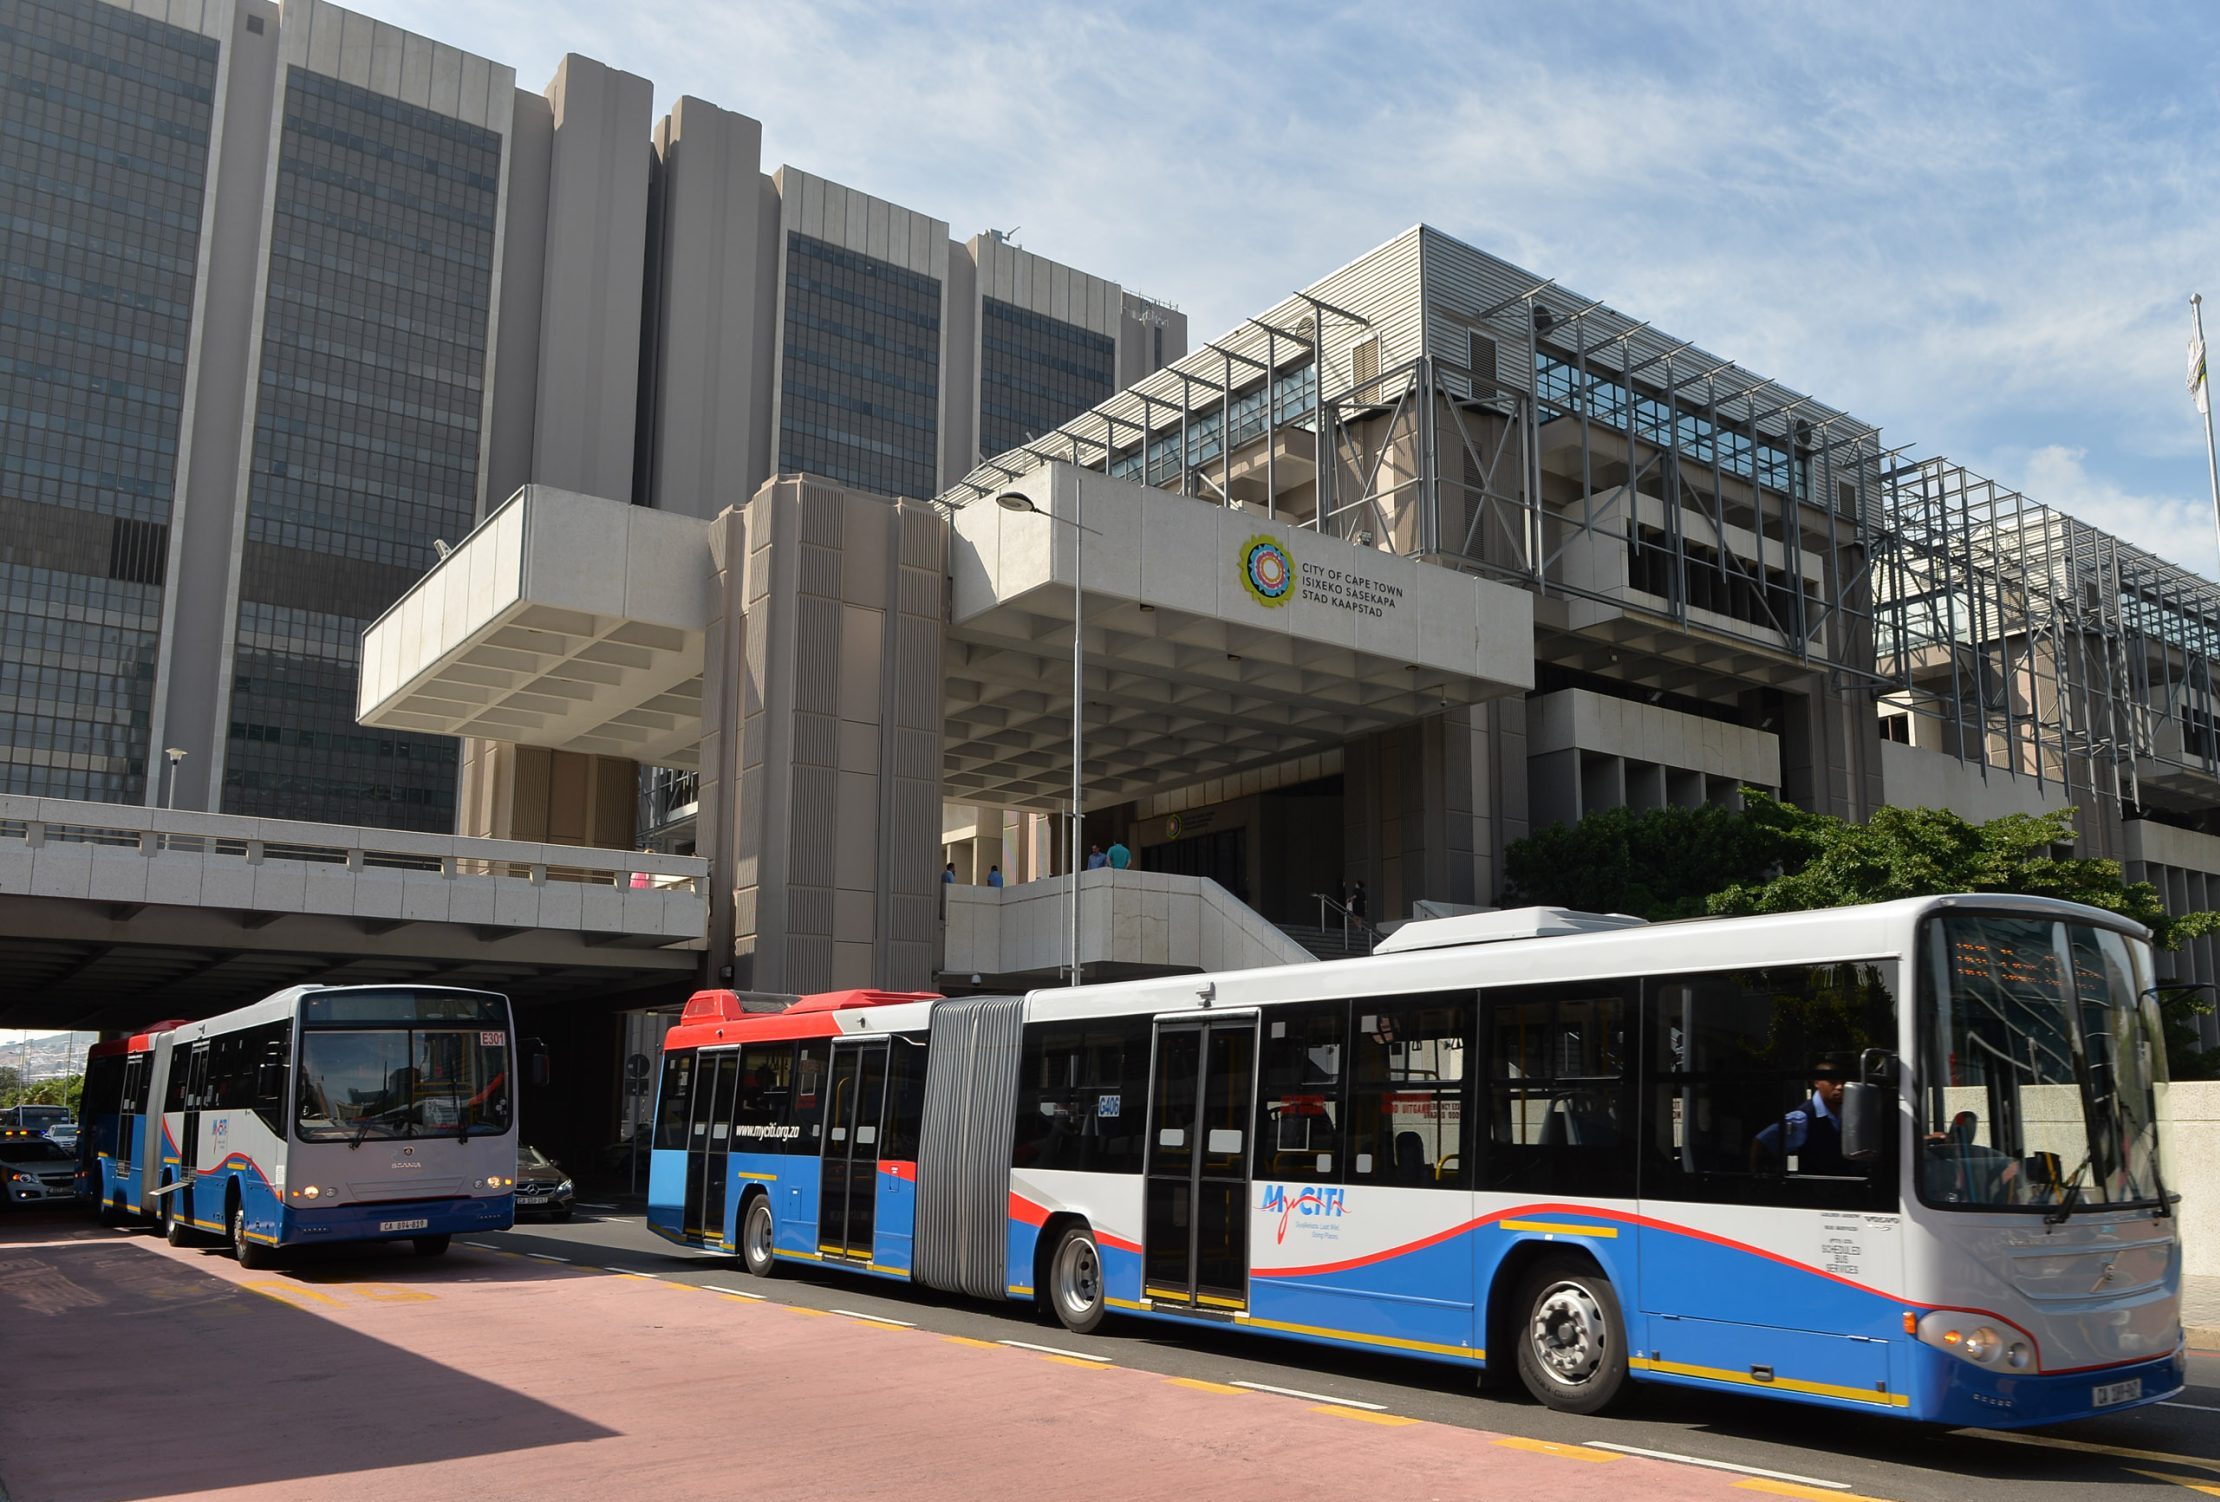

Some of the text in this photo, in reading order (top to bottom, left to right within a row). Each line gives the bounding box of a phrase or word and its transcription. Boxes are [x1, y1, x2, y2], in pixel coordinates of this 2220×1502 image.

[1302, 563, 1403, 597] CITY OF CAPE TOWN
[1302, 576, 1396, 608] ISIXEKO SASEKAPA
[1302, 589, 1383, 617] STAD KAAPSTAD
[482, 1032, 504, 1045] E301
[1821, 1244, 1861, 1256] SCHEDULED
[1826, 1263, 1859, 1274] SERVICES
